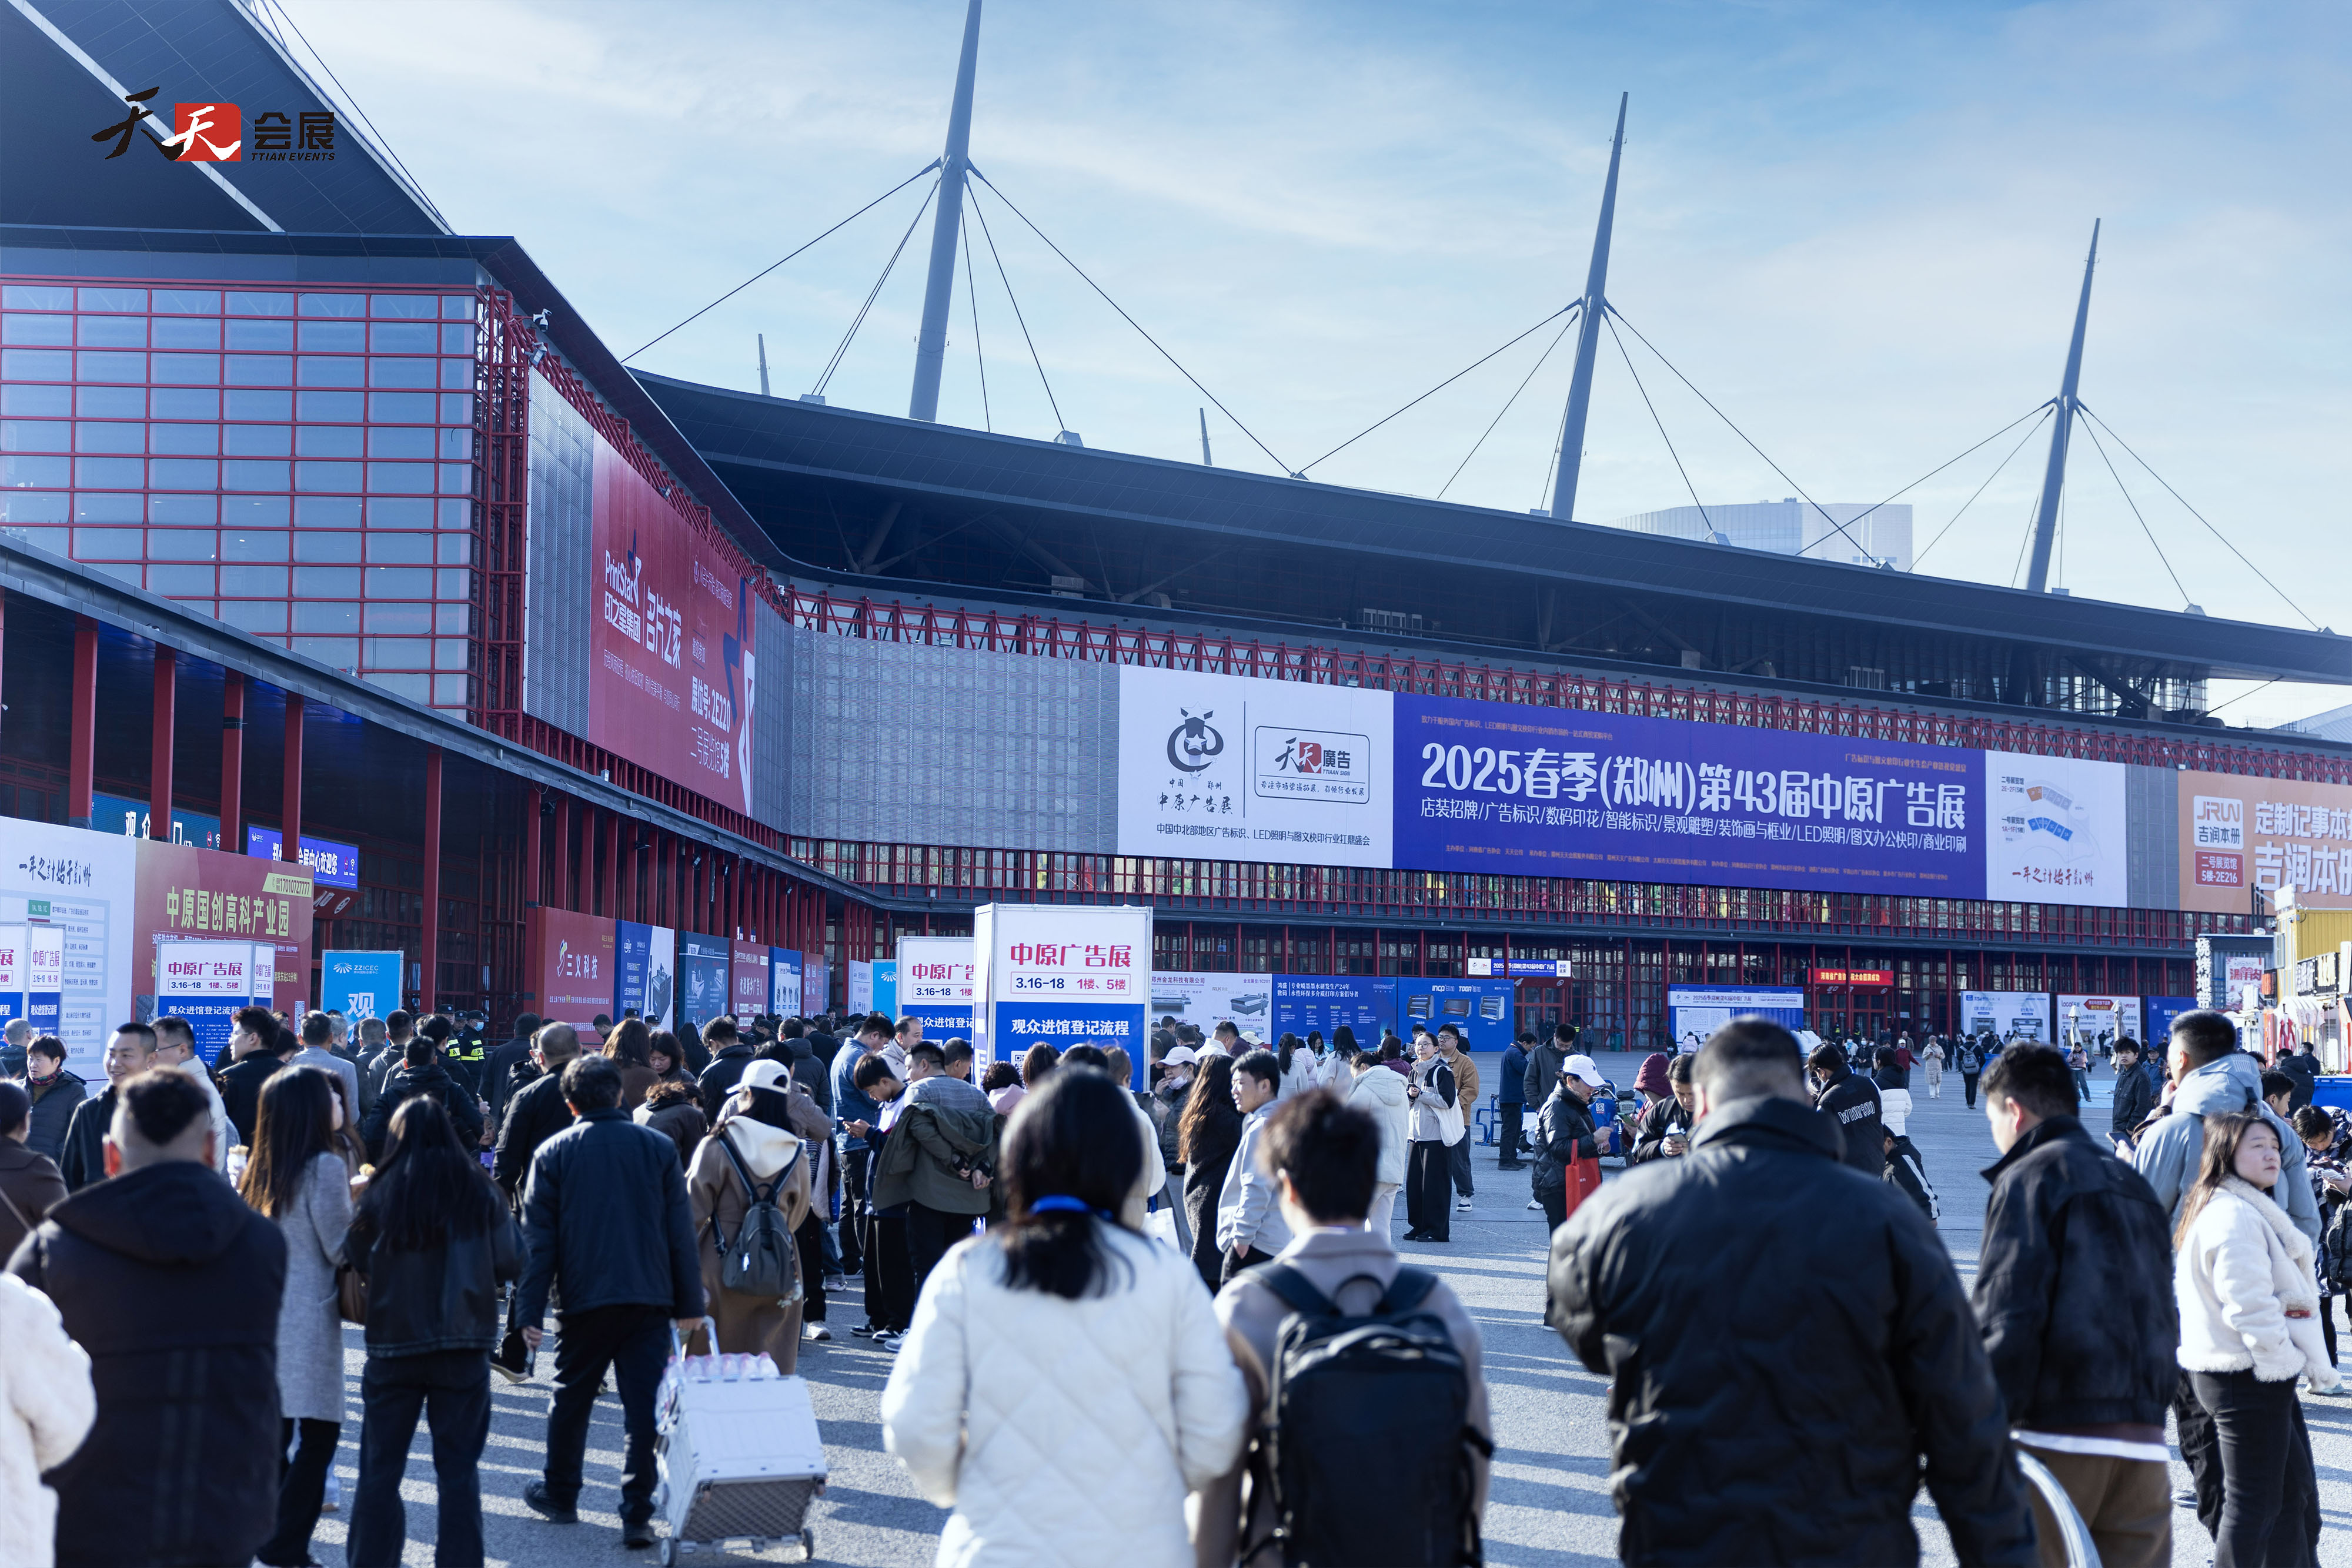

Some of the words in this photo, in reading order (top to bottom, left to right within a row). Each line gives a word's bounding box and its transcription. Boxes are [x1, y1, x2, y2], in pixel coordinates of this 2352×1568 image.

[604, 590, 641, 644] 印之星集团
[647, 584, 681, 670] 名片之家
[690, 726, 730, 780] 二号展览馆5楼
[1323, 750, 1351, 769] 廣告
[1170, 778, 1184, 788] 中国
[1207, 780, 1222, 790] 郑州
[1421, 742, 1966, 830] 2025春季(郑州)第43届中原广告展
[1157, 791, 1233, 815] 中原广告展
[2254, 801, 2352, 841] 定制记事本
[1157, 823, 1370, 847] 中国中北部地区广告标识、LED照明与图文快印行业扛鼎盛会
[2199, 825, 2240, 844] 吉润本册
[2201, 856, 2237, 870] 二号展览馆
[280, 878, 310, 895] 17010727777
[166, 885, 290, 937] 中原国创高科产业园
[33, 950, 60, 967] 中原广告展
[1011, 943, 1131, 967] 中原广告展
[168, 962, 242, 976] 中原广告展
[566, 954, 598, 979] 三义科技
[2196, 938, 2211, 1009] 烧烤地带
[2230, 967, 2262, 981] 涮羊肉
[1016, 978, 1065, 989] 3.16-18
[1077, 978, 1126, 990] 1楼、5楼
[1151, 976, 1205, 984] 郑州金龙科技有限公司
[168, 1005, 240, 1015] 观众进馆登记流程
[348, 992, 375, 1018] 观
[1011, 1019, 1130, 1036] 观众进馆登记流程
